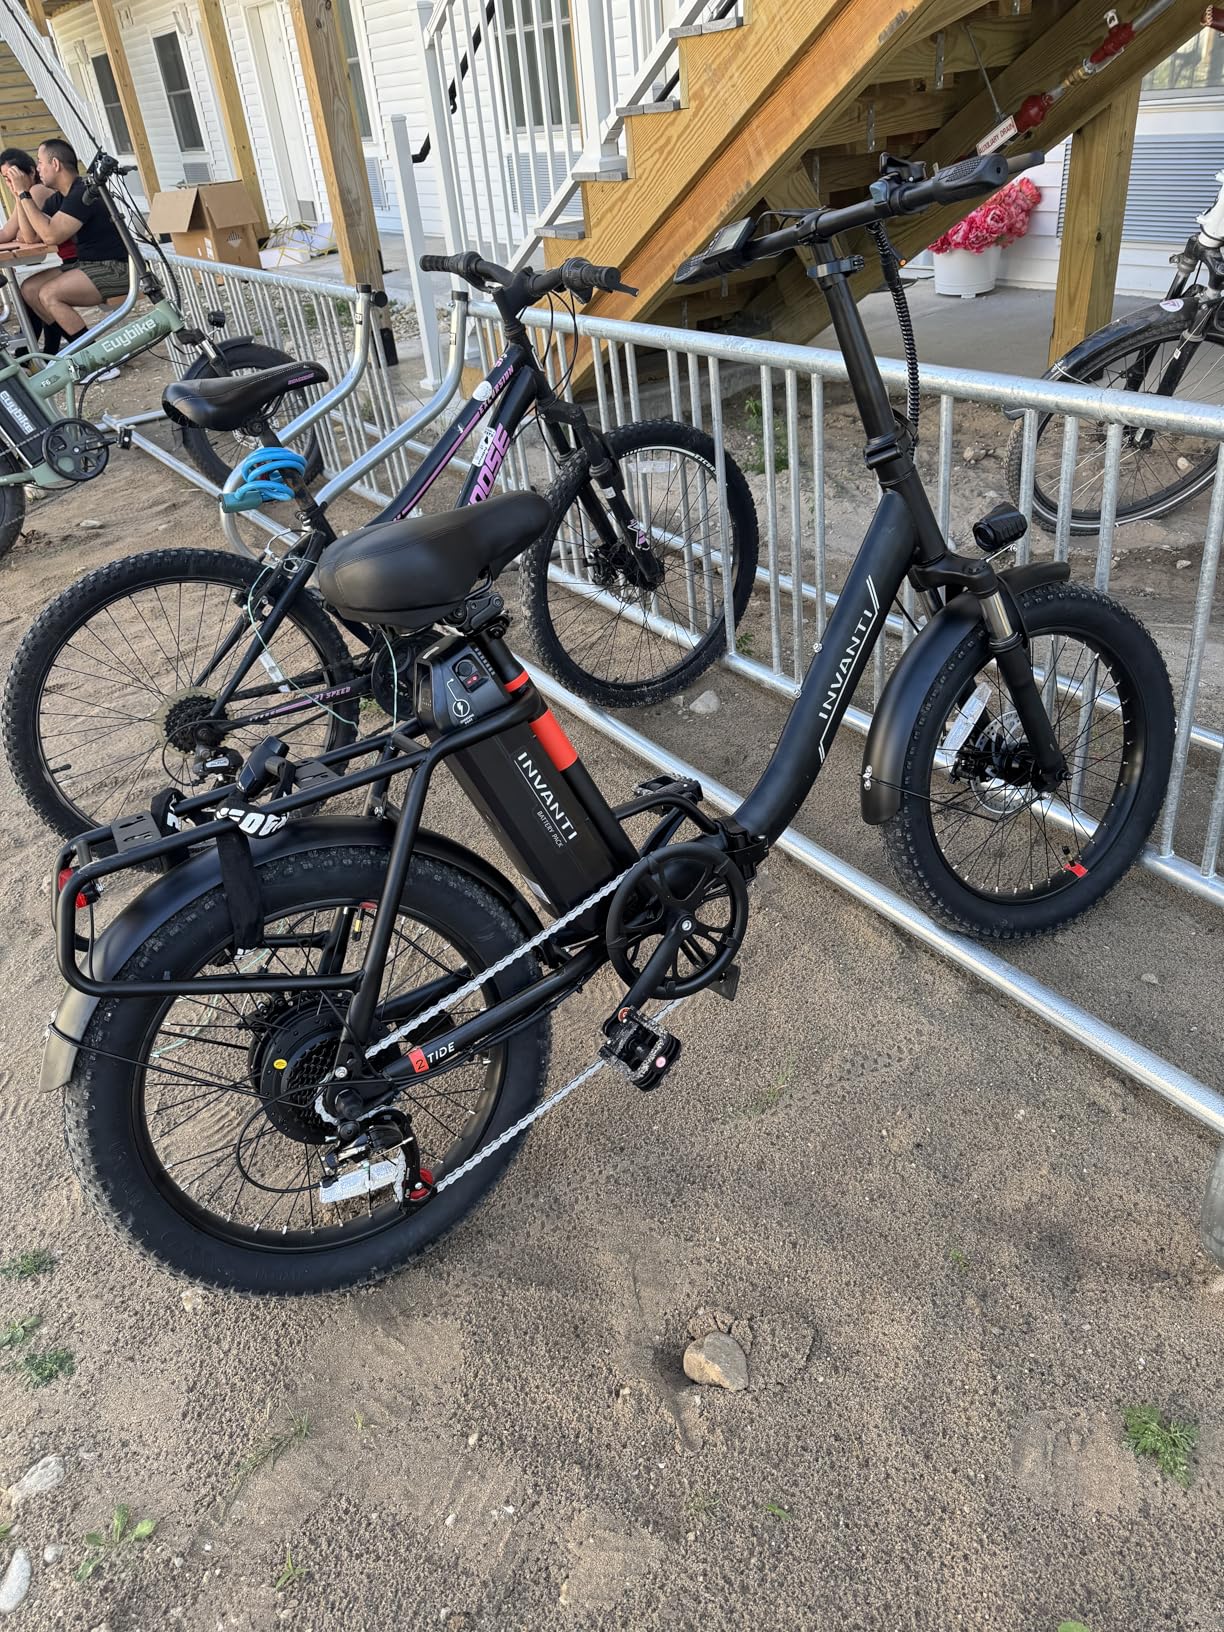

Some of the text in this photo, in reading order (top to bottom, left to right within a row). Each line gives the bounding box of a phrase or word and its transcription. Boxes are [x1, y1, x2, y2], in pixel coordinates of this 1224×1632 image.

[999, 122, 1016, 138] DRAIN
[101, 317, 157, 353] Euybike
[0, 390, 36, 435] Euybike
[468, 422, 511, 505] OOSE
[818, 609, 873, 720] INVANTI
[325, 686, 352, 700] SPEED
[517, 751, 578, 840] INVANTI
[536, 810, 564, 848] BATTERY PACK
[426, 1041, 456, 1064] TIDE
